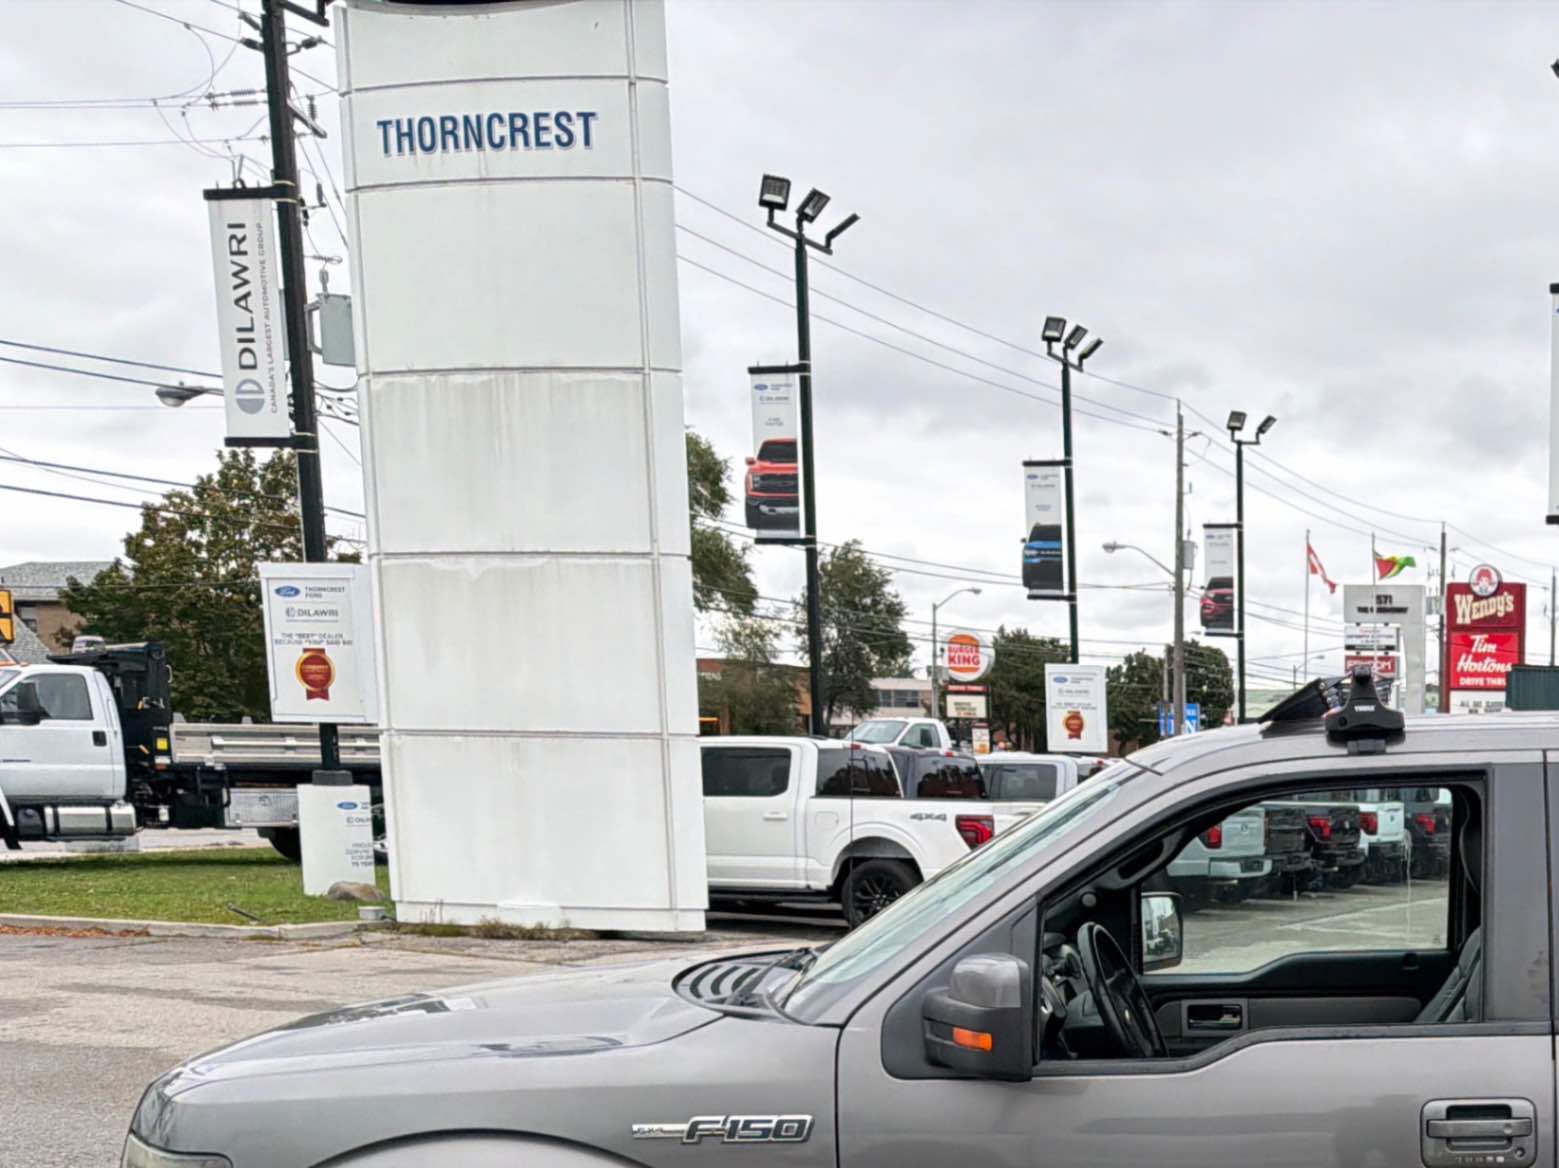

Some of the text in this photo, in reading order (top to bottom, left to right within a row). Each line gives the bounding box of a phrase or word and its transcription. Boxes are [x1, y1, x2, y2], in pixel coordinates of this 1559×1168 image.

[376, 110, 598, 156] THORNCREST
[256, 222, 265, 256] GROUP
[227, 222, 258, 370] DILAWRI
[259, 259, 270, 320] AUTOMOTIVE
[264, 323, 274, 365] LARGEST
[297, 608, 339, 617] DILAWRI
[948, 645, 980, 654] BURGER
[1470, 634, 1498, 653] Tim
[948, 655, 980, 666] KING
[1457, 654, 1512, 673] Hortons
[1459, 677, 1484, 686] DRIVE
